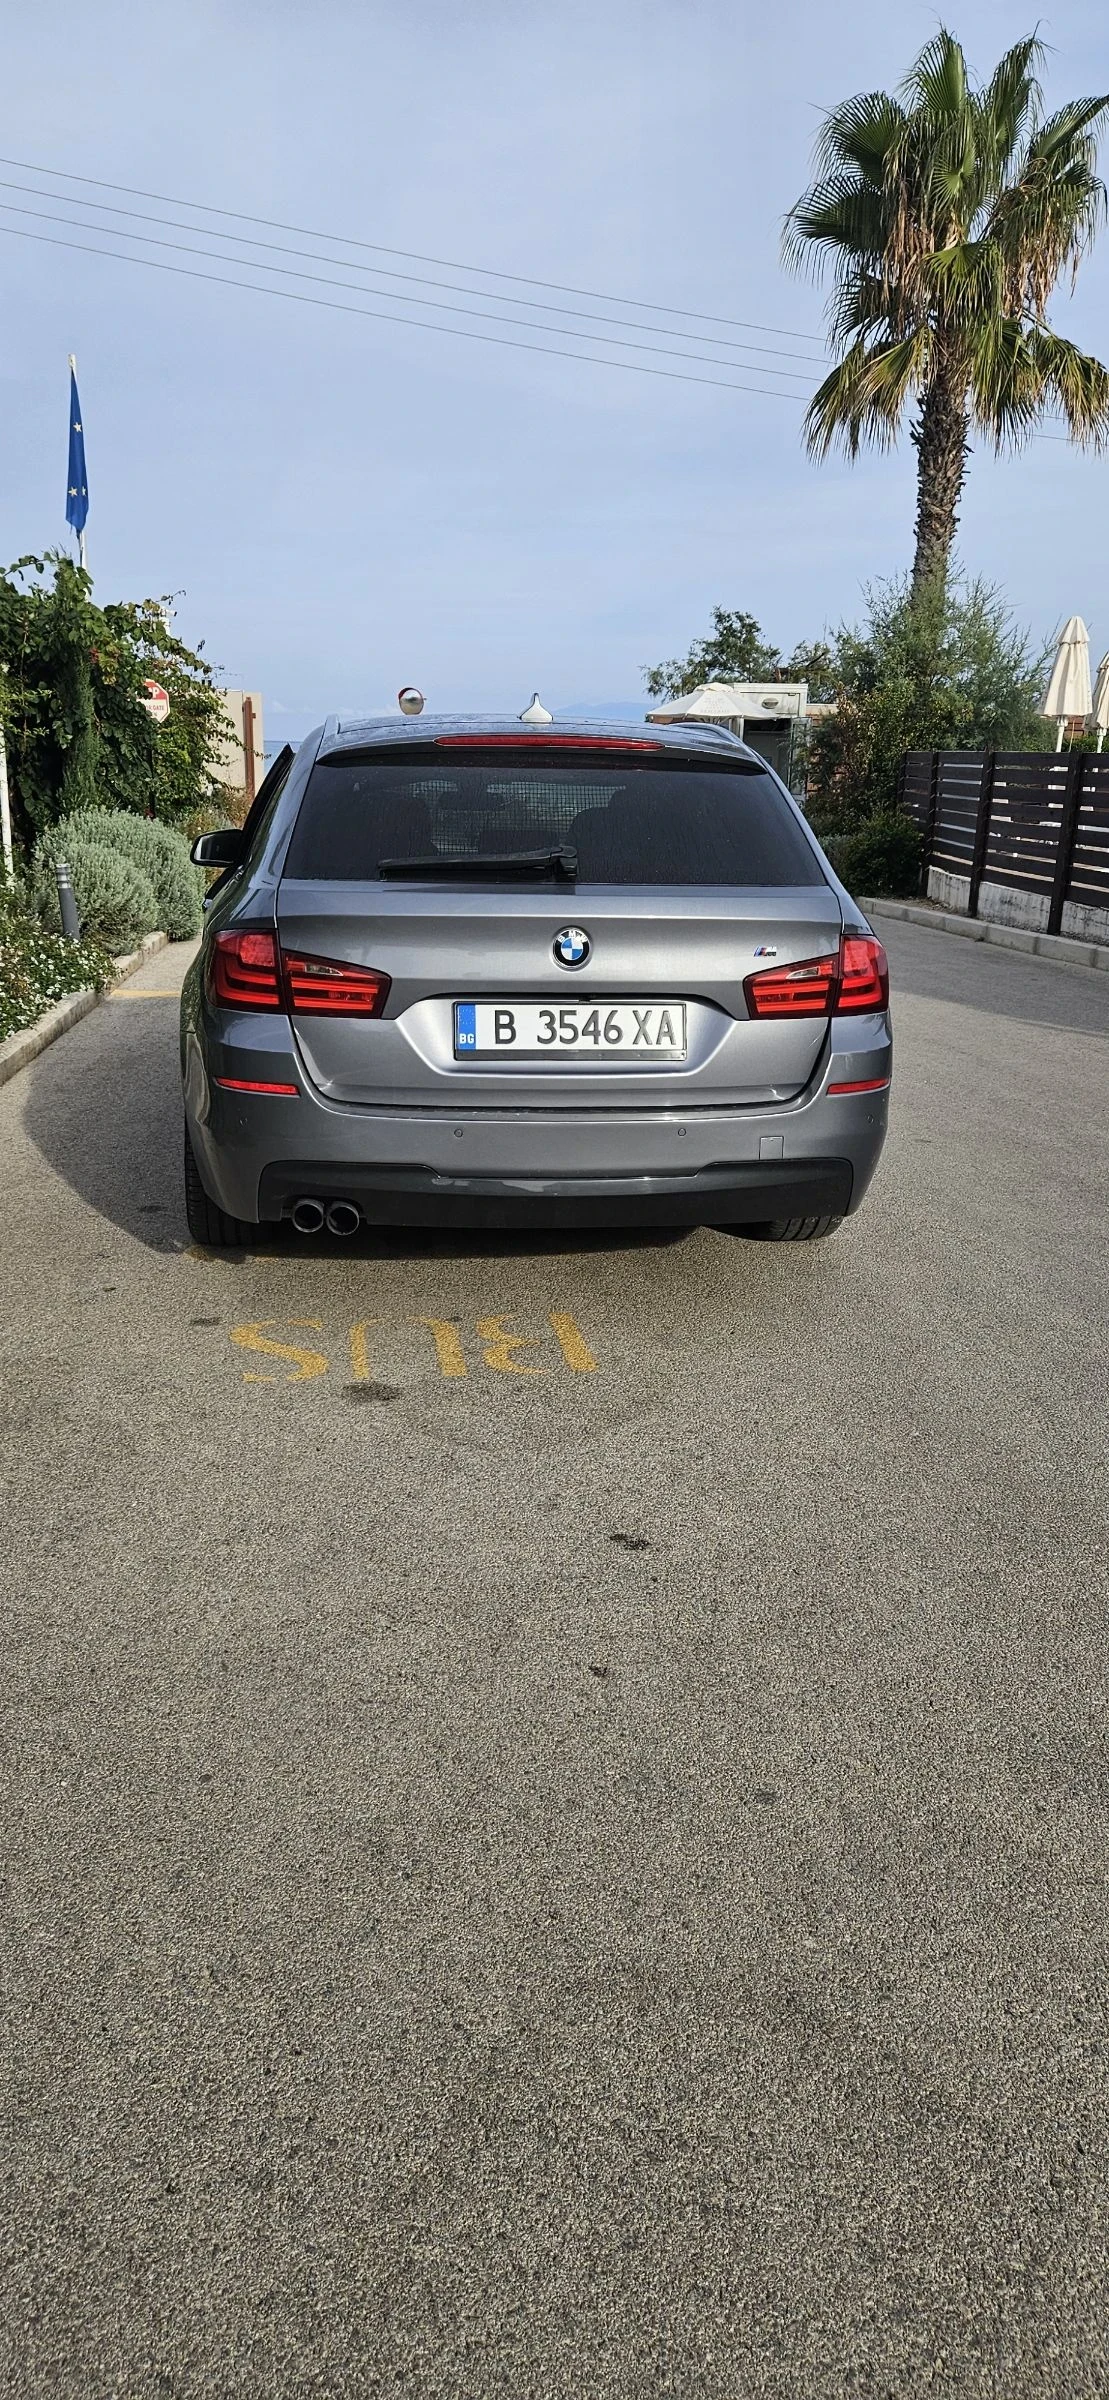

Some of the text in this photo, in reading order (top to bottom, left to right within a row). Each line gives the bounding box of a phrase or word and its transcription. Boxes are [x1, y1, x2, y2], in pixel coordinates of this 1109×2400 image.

[557, 930, 588, 943] BMW
[459, 1033, 475, 1044] BG
[494, 1009, 677, 1045] B 3546 XA
[230, 1312, 598, 1383] BUS
